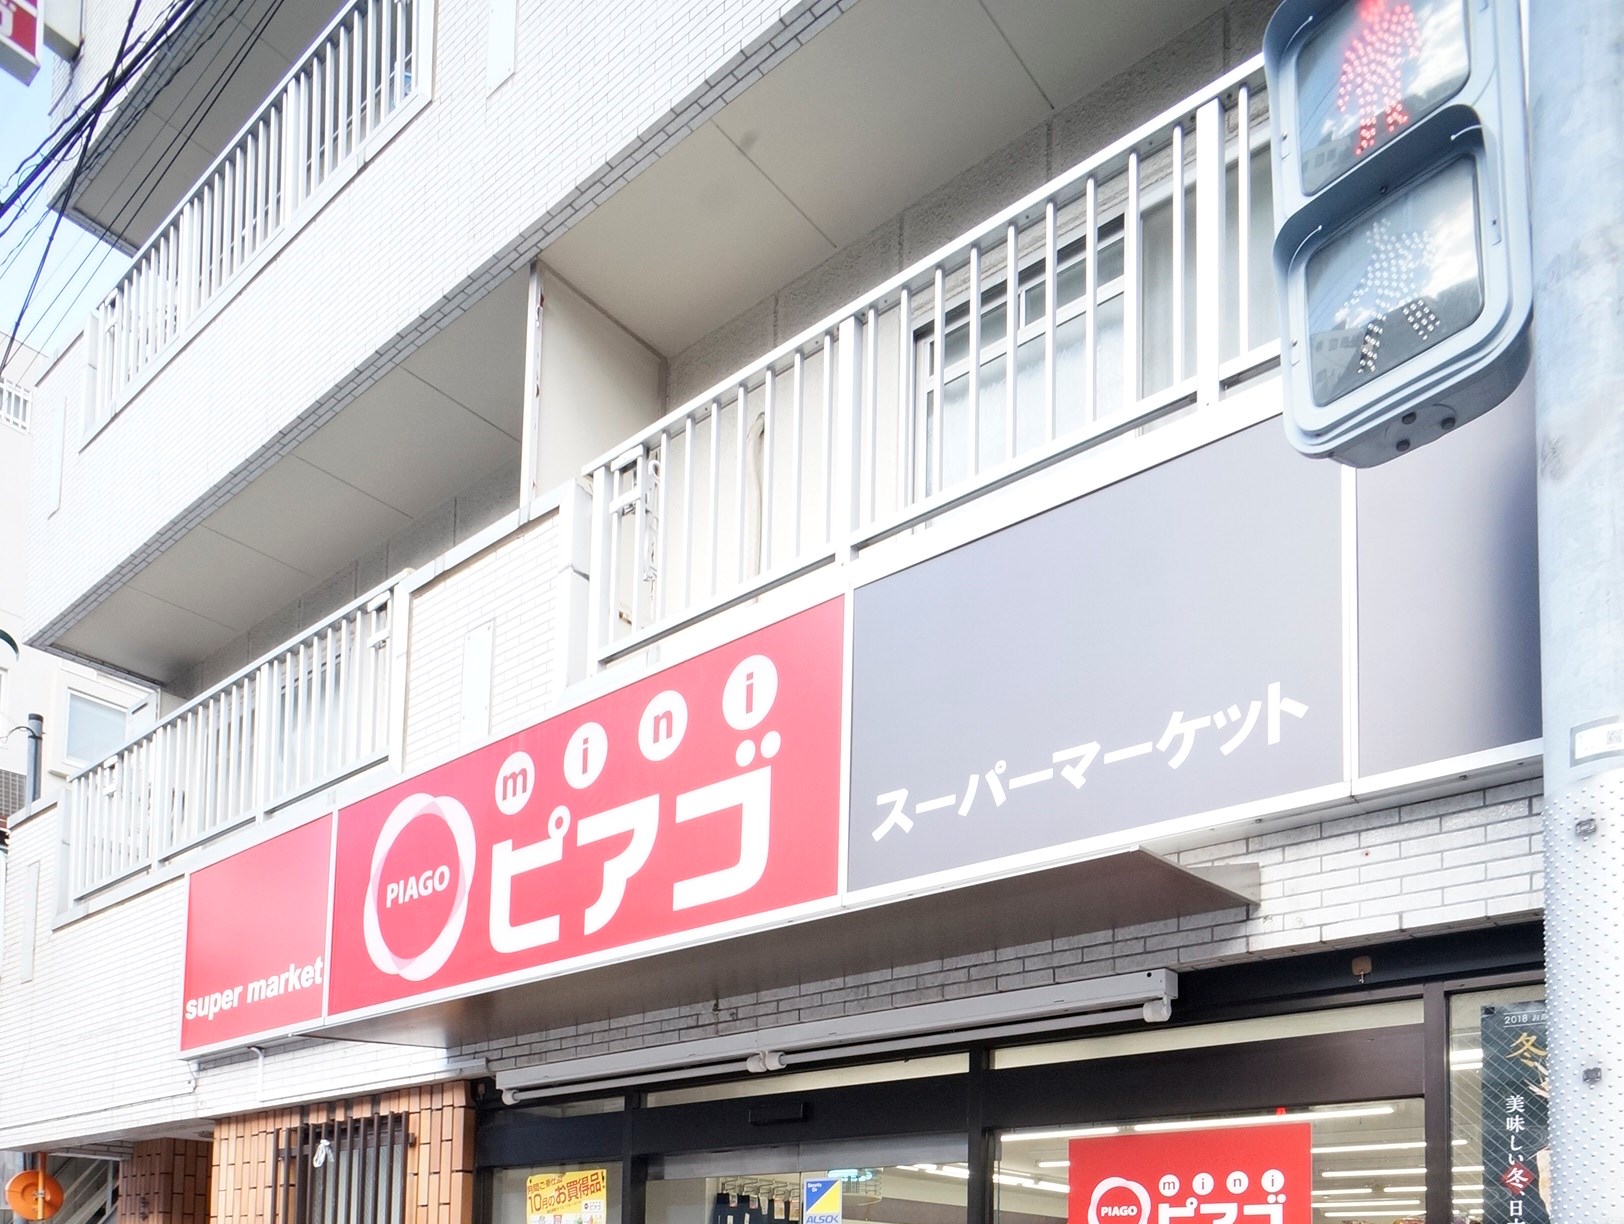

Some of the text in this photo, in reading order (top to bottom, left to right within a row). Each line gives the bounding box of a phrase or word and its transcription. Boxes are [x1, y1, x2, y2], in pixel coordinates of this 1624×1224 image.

[498, 664, 766, 806] mini
[871, 682, 1309, 842] スーパーマーケット
[489, 730, 782, 953] ピアゴ
[385, 864, 451, 909] PIAGO
[184, 955, 324, 1021] super market
[1504, 1014, 1528, 1025] 2018
[1160, 1172, 1280, 1194] mini
[806, 1215, 840, 1224] ALSOK
[1100, 1205, 1138, 1218] PIAGO
